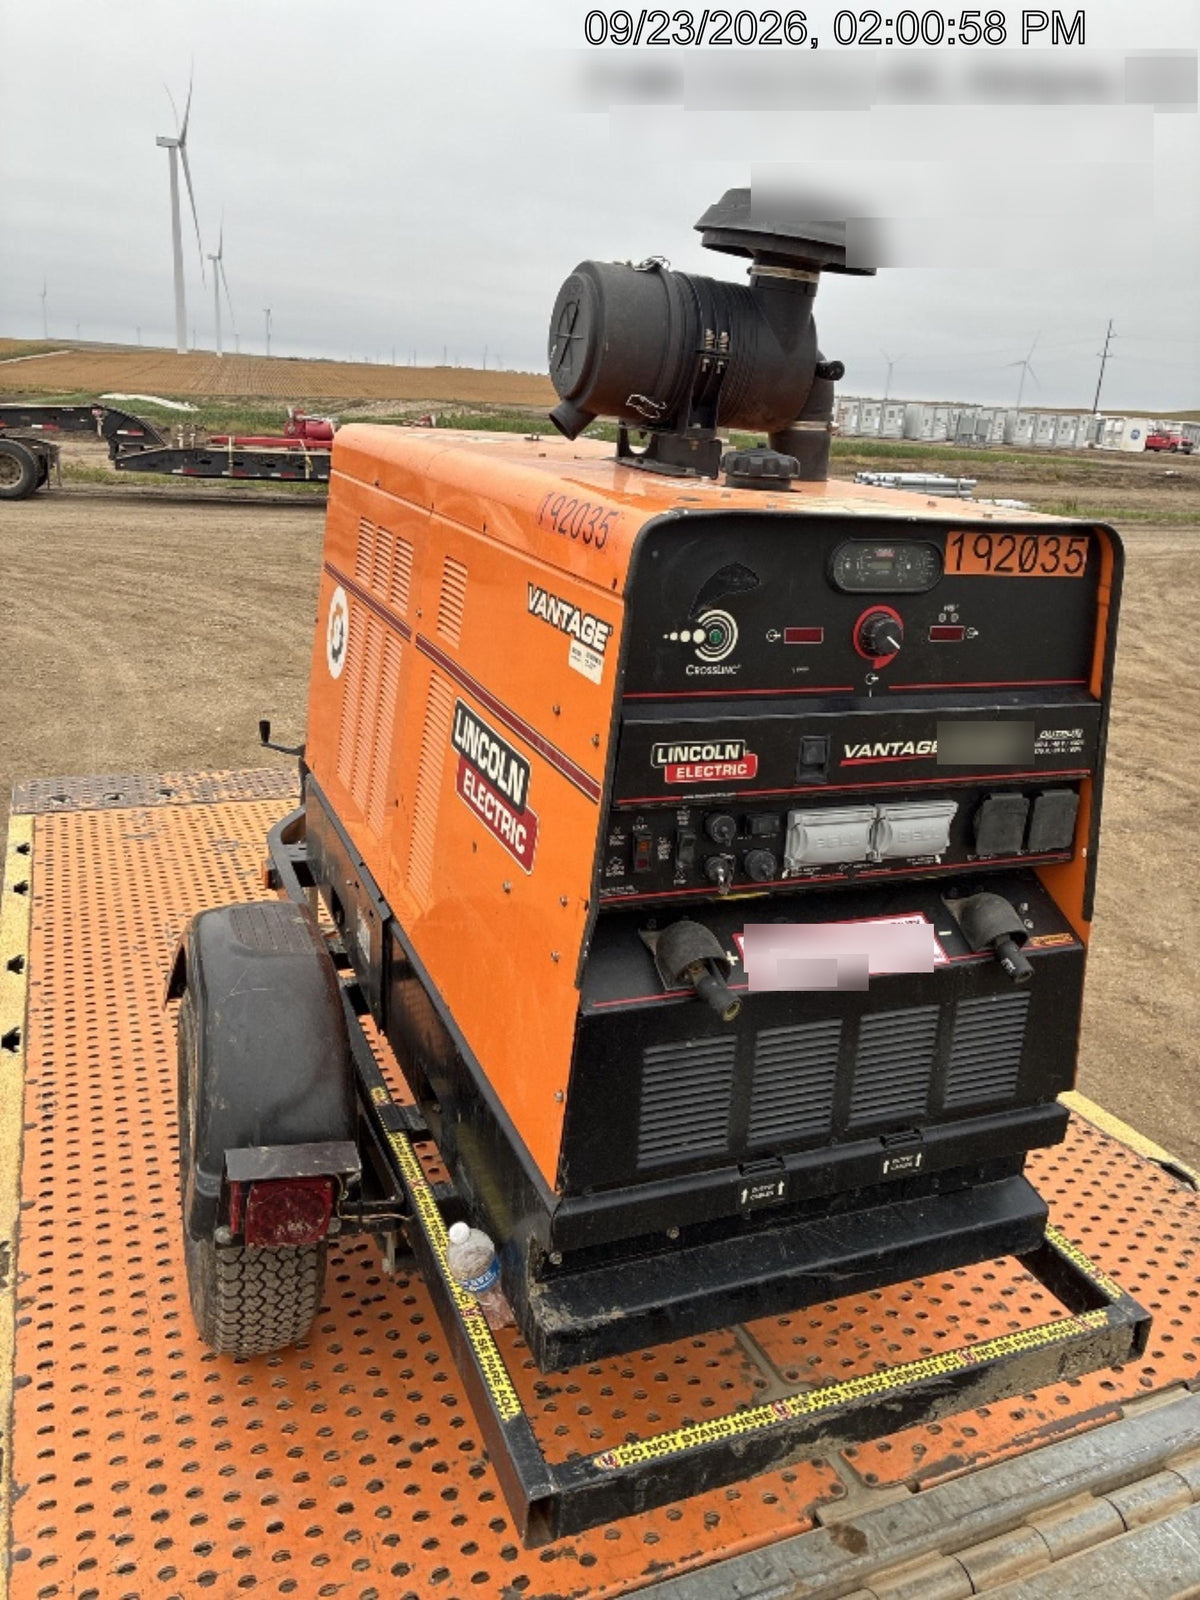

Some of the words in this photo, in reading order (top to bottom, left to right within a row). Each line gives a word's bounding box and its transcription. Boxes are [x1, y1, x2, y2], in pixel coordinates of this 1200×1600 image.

[538, 491, 619, 549] 192035
[951, 533, 1087, 575] 192035
[528, 584, 610, 653] VANTAGE
[454, 707, 526, 807] LINCOLN
[656, 743, 741, 764] LINCOLN
[675, 763, 748, 779] ELECTRIC
[463, 767, 528, 855] ELECTRIC
[470, 1319, 483, 1336] NO
[477, 1337, 491, 1354] SE
[484, 1354, 505, 1387] PARE
[975, 1346, 996, 1358] NO
[812, 1390, 842, 1405] PAS
[842, 1378, 889, 1396] TENEZ
[941, 1356, 962, 1369] ICI
[619, 1446, 646, 1461] DO
[644, 1437, 679, 1455] NOT
[680, 1423, 732, 1445] STAND
[733, 1410, 773, 1429] HERE
